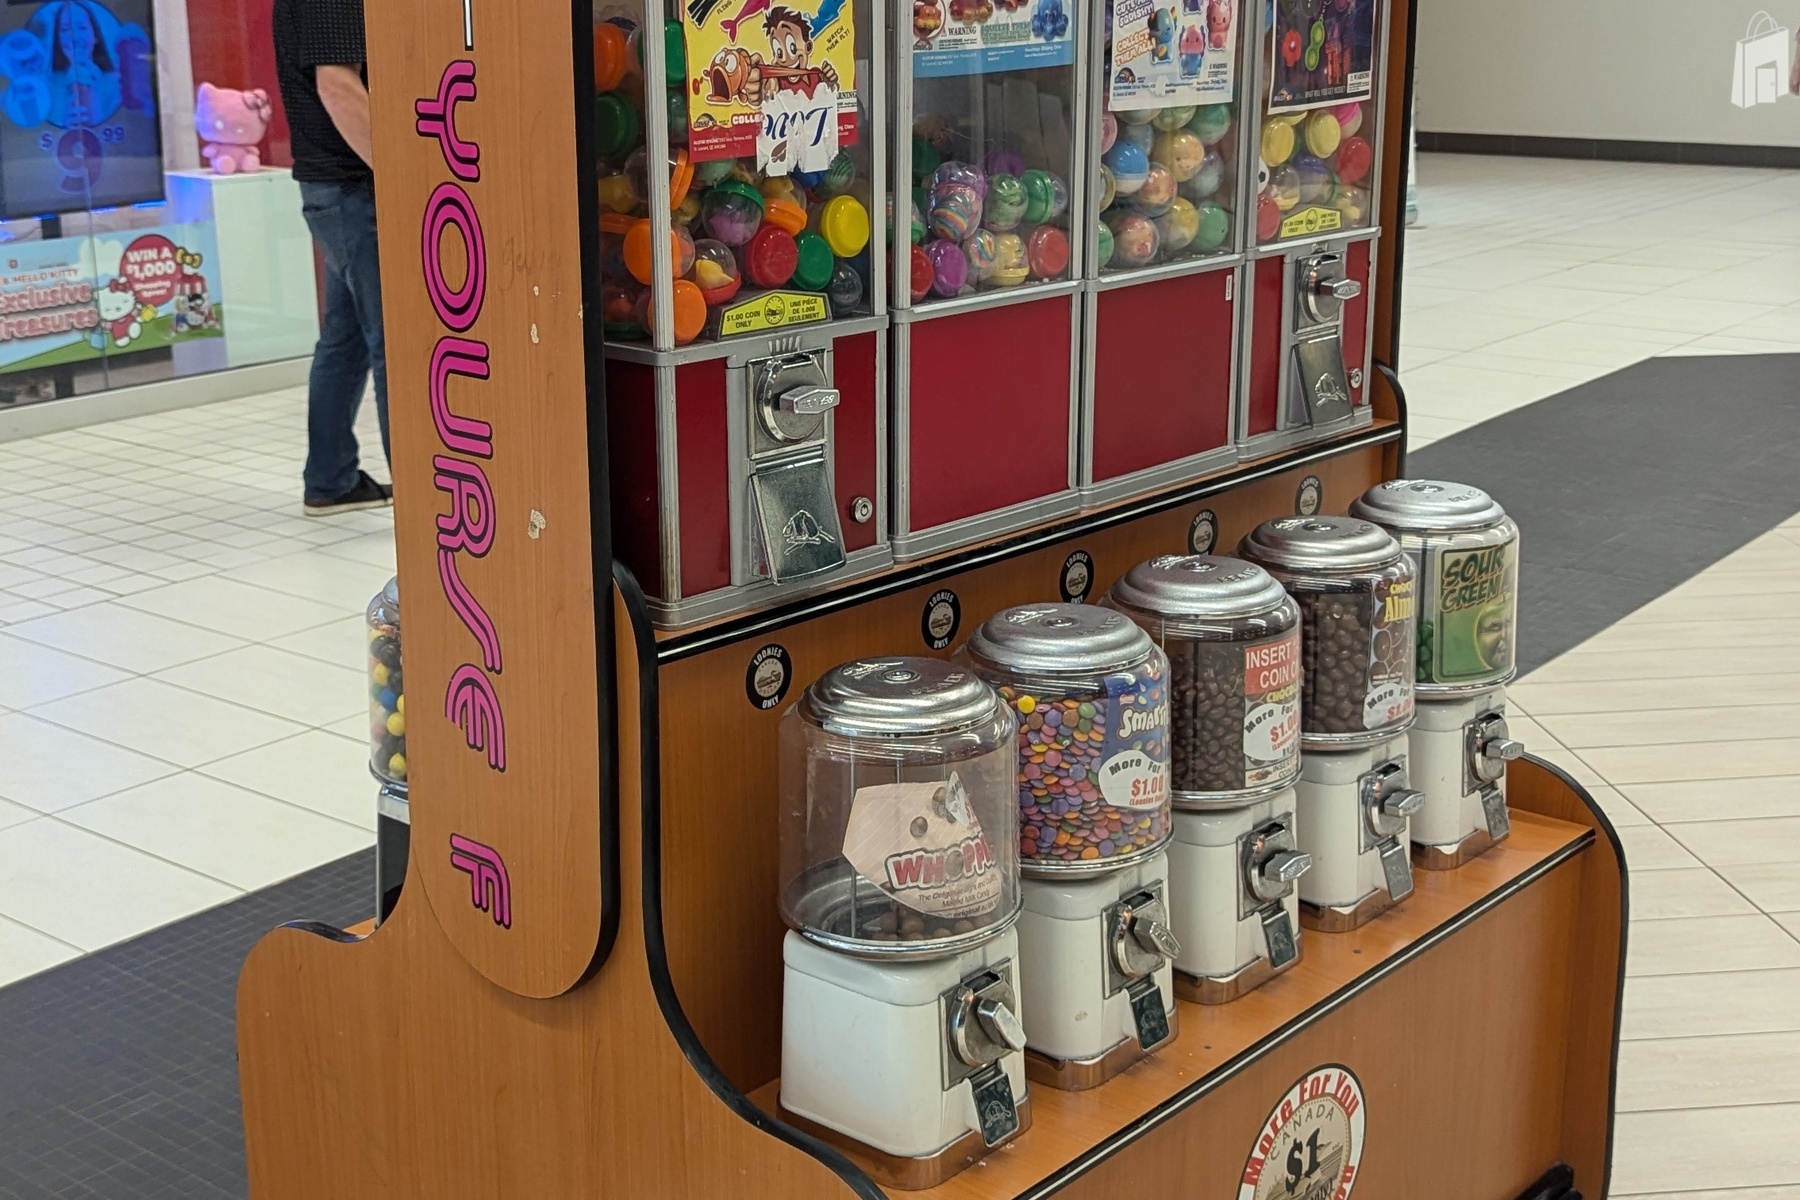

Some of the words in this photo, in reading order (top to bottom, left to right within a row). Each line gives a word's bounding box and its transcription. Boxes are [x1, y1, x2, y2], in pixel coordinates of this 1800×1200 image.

[948, 26, 977, 36] WARNING
[1117, 28, 1150, 52] COLLECT
[127, 248, 158, 262] WIN
[161, 246, 173, 260] A
[13, 272, 48, 283] HELLO
[126, 260, 176, 280] $1,000
[790, 299, 802, 308] UNE
[726, 313, 744, 323] $1.00
[745, 310, 760, 319] COIN
[735, 320, 752, 329] ONLY
[1066, 553, 1088, 568] LOONIES
[1445, 545, 1505, 587] SOUR
[929, 592, 954, 607] LOONIES
[934, 637, 948, 649] ONLY
[753, 647, 783, 666] LOONIES
[1246, 642, 1291, 669] INSERT
[1260, 664, 1289, 689] COIN
[762, 694, 779, 709] ONLY
[1367, 689, 1394, 709] More
[1245, 708, 1274, 734] More
[1281, 705, 1293, 715] For
[1270, 709, 1297, 743] $1.00
[1109, 758, 1142, 776] More
[1148, 761, 1161, 774] For
[1131, 775, 1163, 798] $1.00
[954, 905, 981, 917] original
[1244, 1099, 1293, 1186] More
[1299, 1074, 1331, 1103] For
[1334, 1072, 1360, 1119] You
[1270, 1104, 1335, 1161] CANADA
[1285, 1127, 1321, 1196] $1
